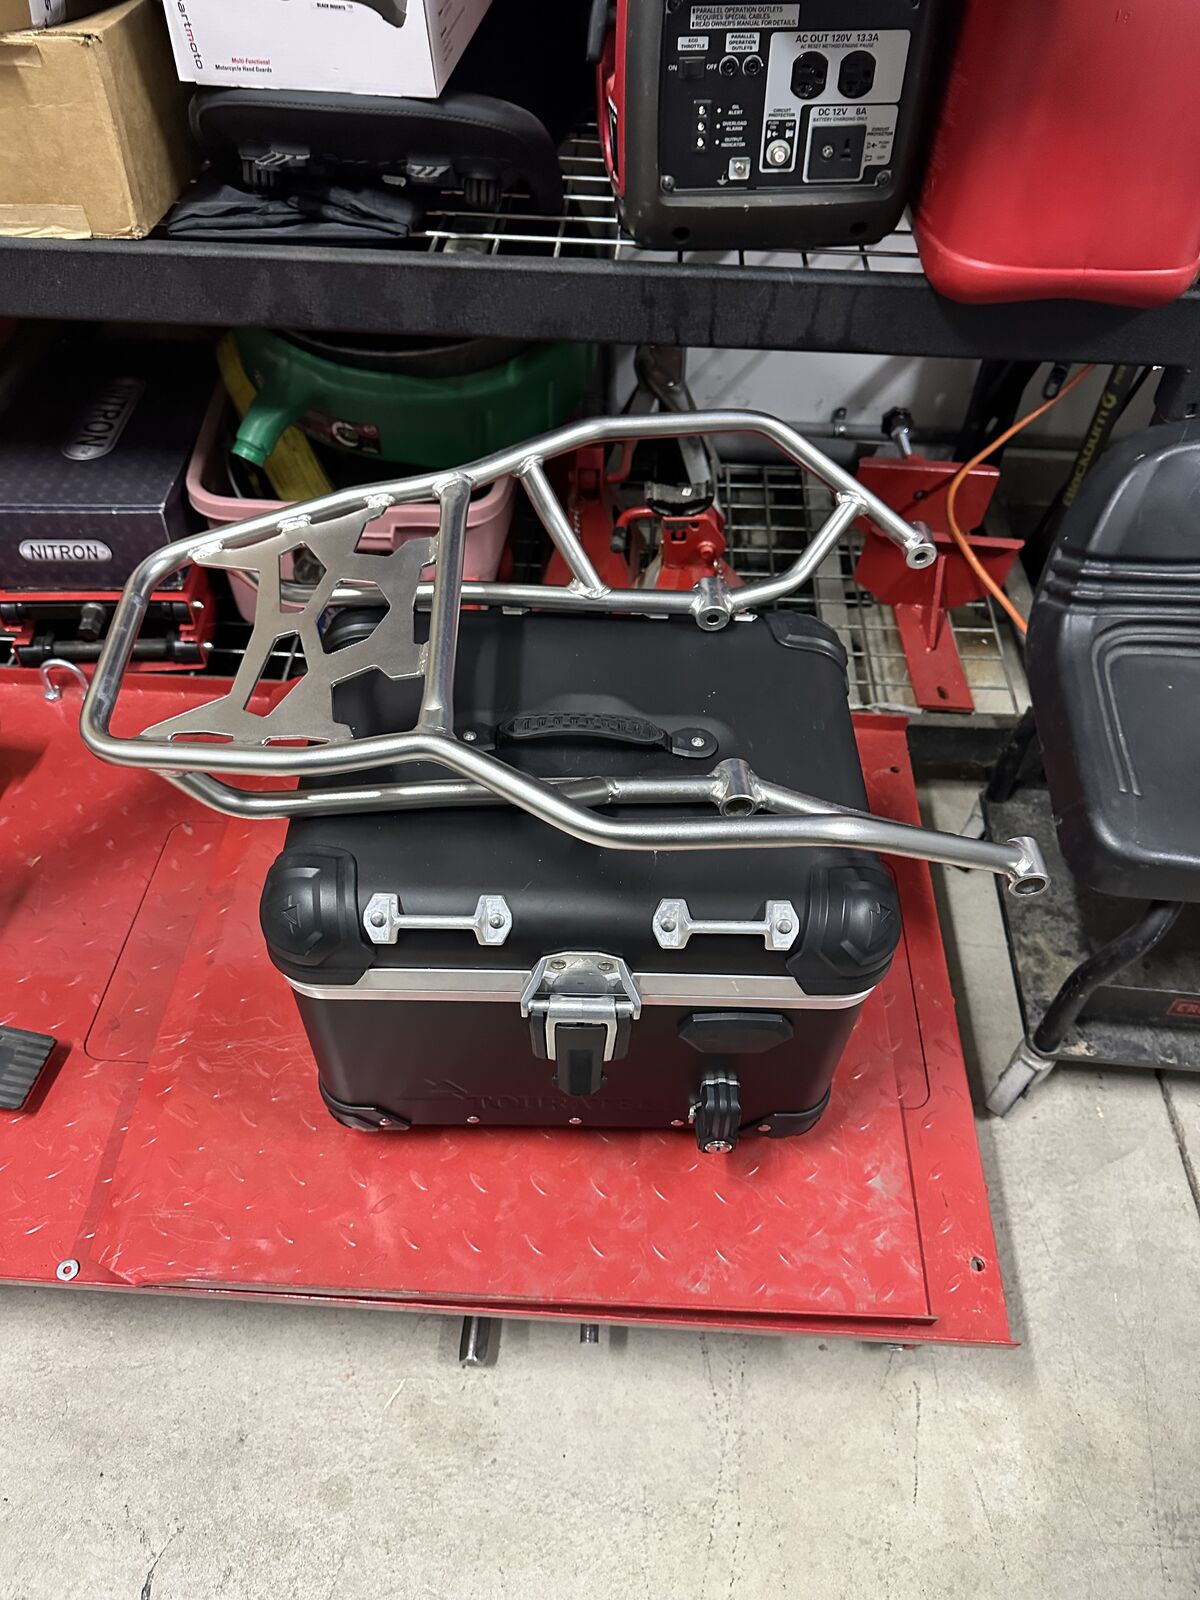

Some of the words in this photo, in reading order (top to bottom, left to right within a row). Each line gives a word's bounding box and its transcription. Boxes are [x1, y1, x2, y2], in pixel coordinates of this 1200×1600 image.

[178, 0, 203, 70] artmoto
[796, 34, 808, 42] AC
[810, 34, 829, 42] OUT
[832, 33, 852, 42] 120V
[857, 33, 879, 42] 13.3A
[818, 108, 830, 116] DC
[832, 108, 848, 116] 12V
[856, 107, 866, 116] 8A
[30, 544, 99, 560] NITRON
